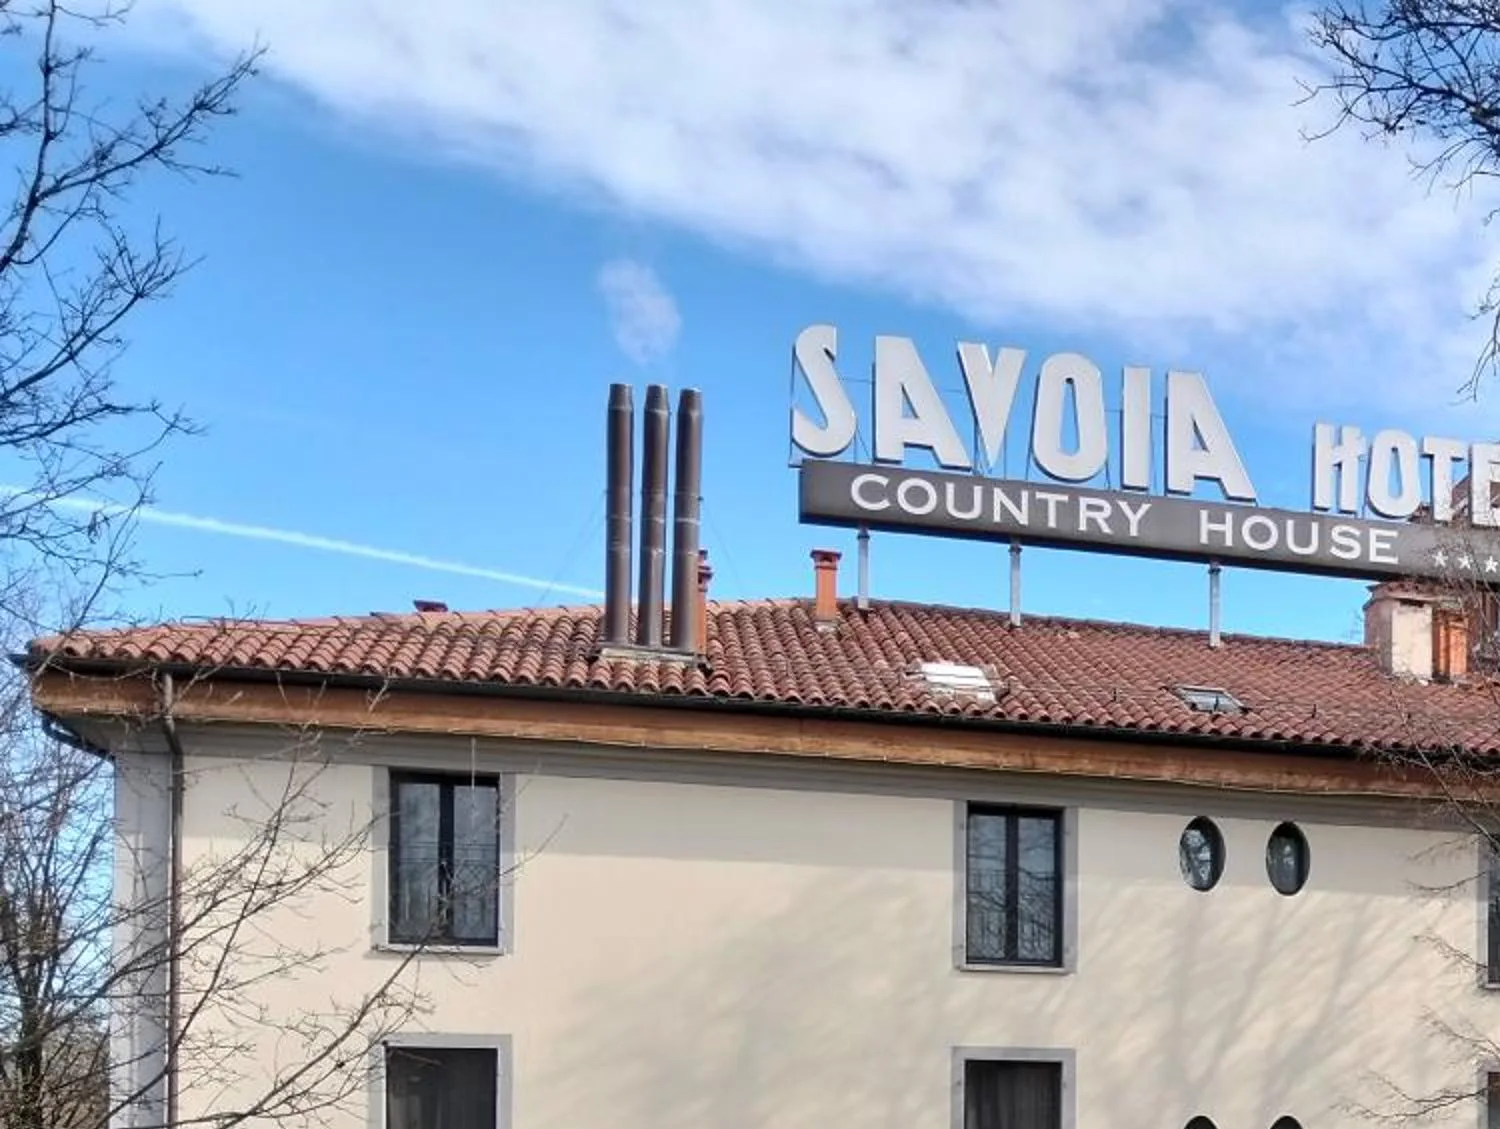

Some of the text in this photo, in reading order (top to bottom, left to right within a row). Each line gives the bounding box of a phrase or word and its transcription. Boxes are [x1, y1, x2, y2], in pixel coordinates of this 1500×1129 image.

[791, 324, 1258, 502] SAVOIA
[850, 473, 1399, 565] COUNTRY HOUSE
